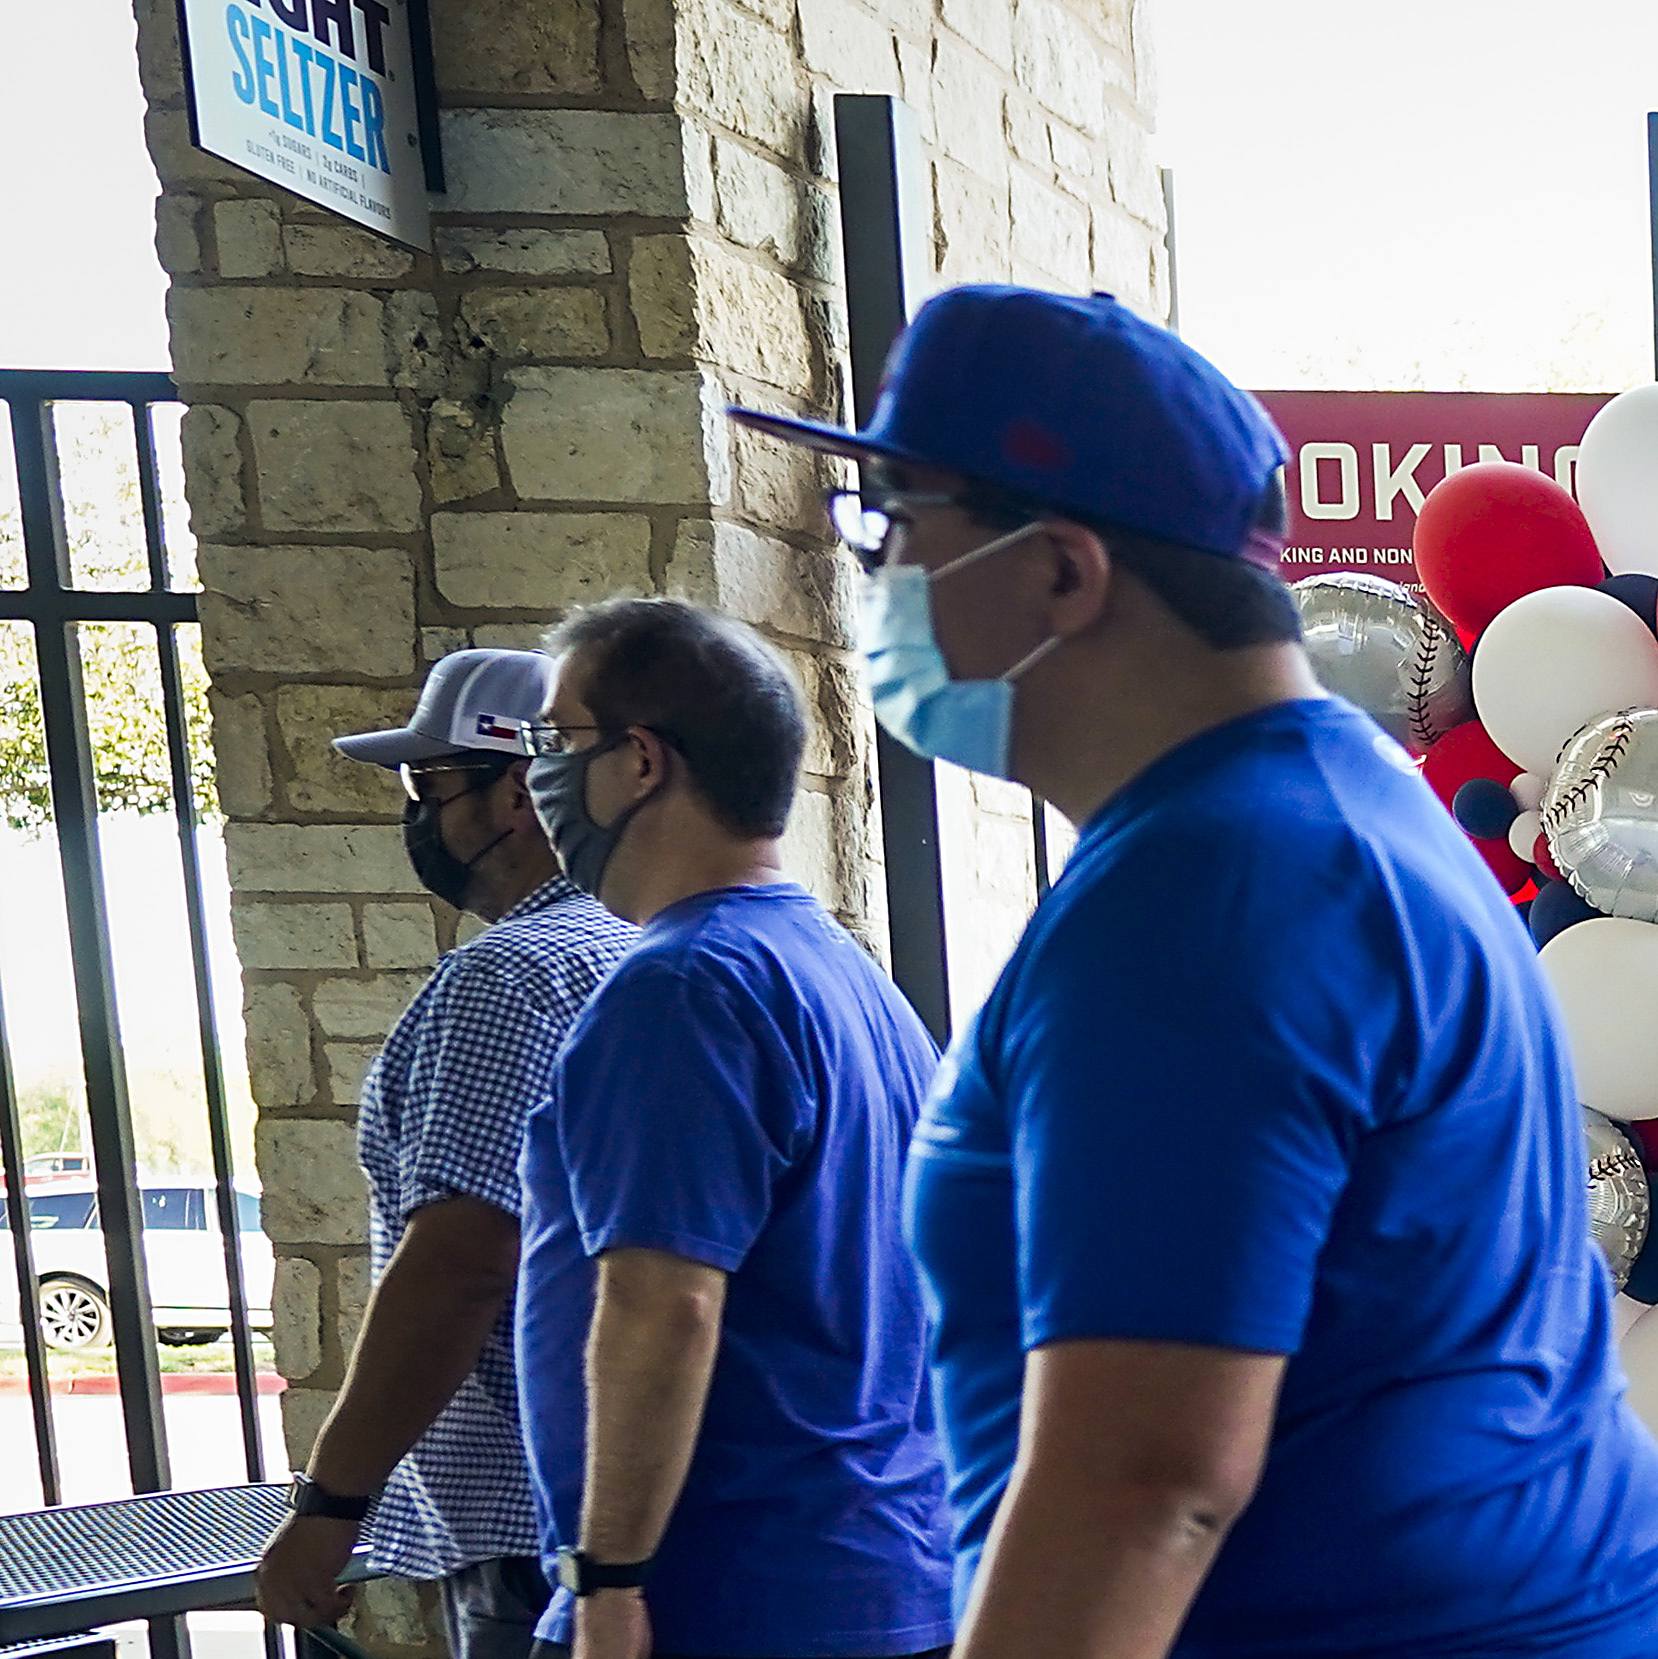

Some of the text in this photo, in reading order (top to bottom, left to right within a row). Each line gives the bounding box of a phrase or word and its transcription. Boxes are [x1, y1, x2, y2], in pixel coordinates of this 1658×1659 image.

[226, 3, 391, 175] SELTZER
[246, 139, 391, 220] GLUTEN FREE NO ARTIFICIAL FLAVORS
[282, 134, 312, 160] SUGARS
[334, 160, 358, 183] CARBS
[1328, 548, 1368, 564] AND
